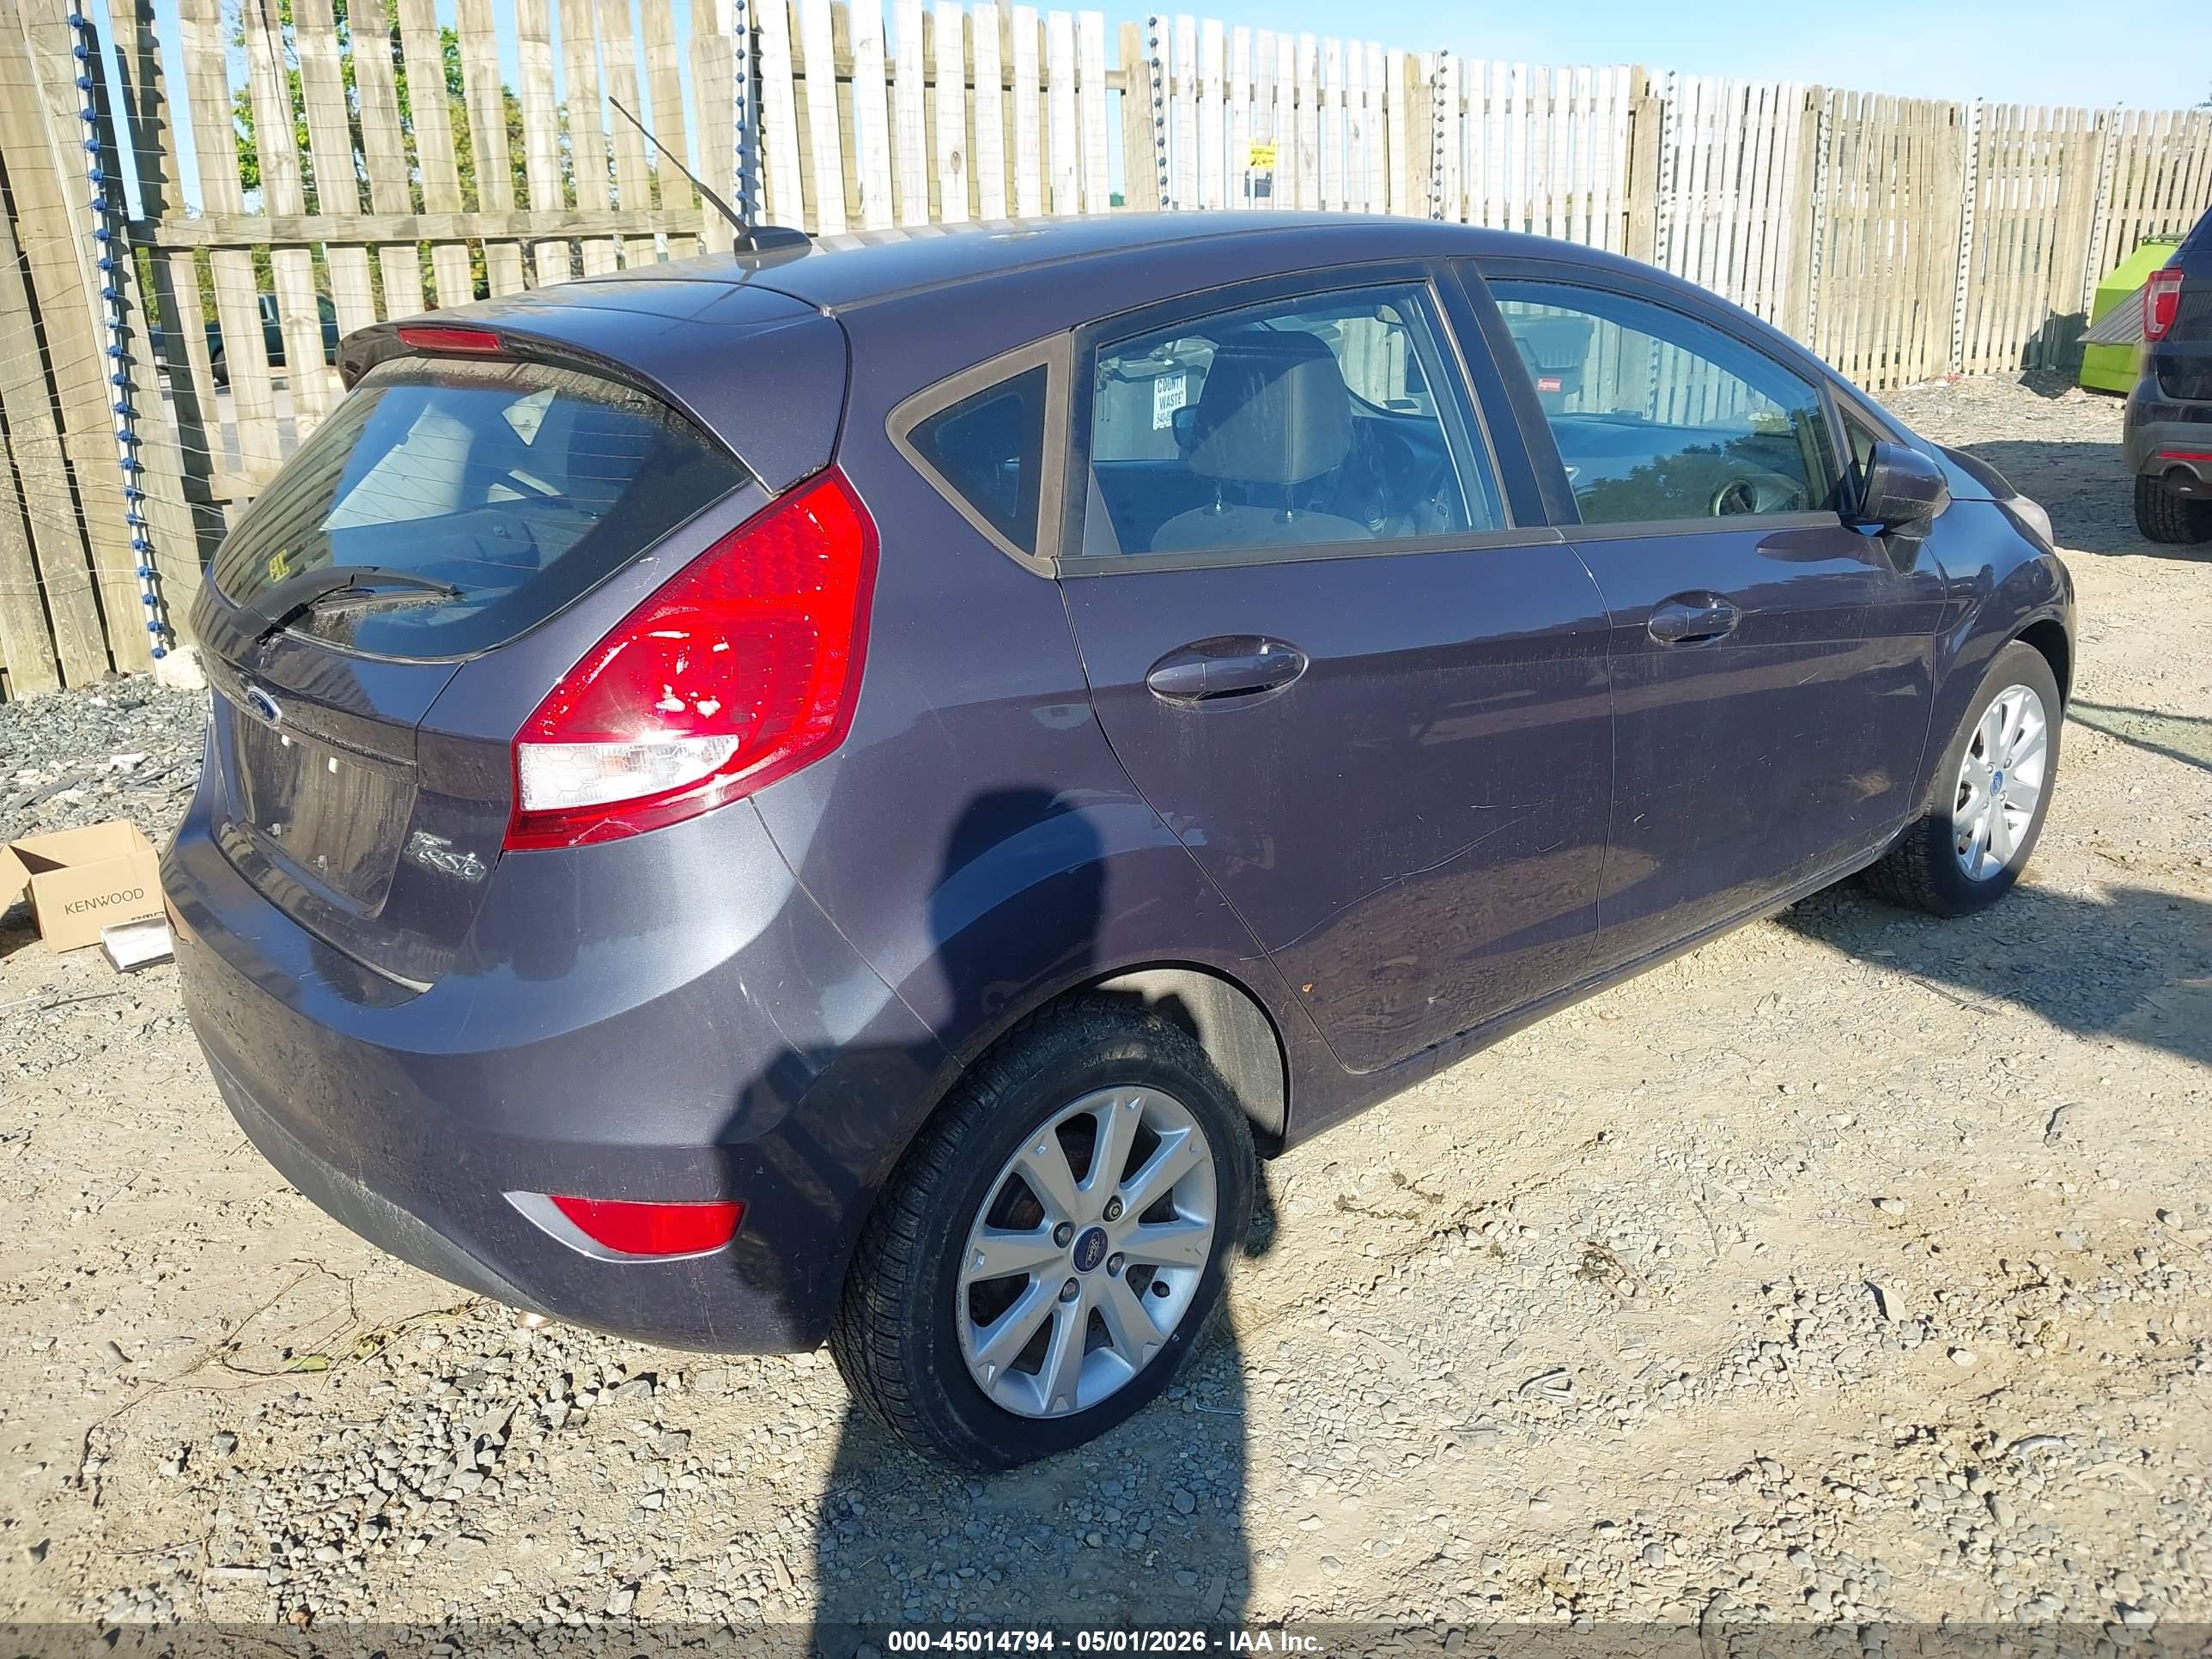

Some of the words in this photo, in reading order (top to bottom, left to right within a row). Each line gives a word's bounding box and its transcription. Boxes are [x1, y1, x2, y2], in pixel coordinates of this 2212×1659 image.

[1158, 376, 1183, 393] COUNTY
[64, 888, 144, 915] KENWOOD
[1086, 1238, 1100, 1262] Ford
